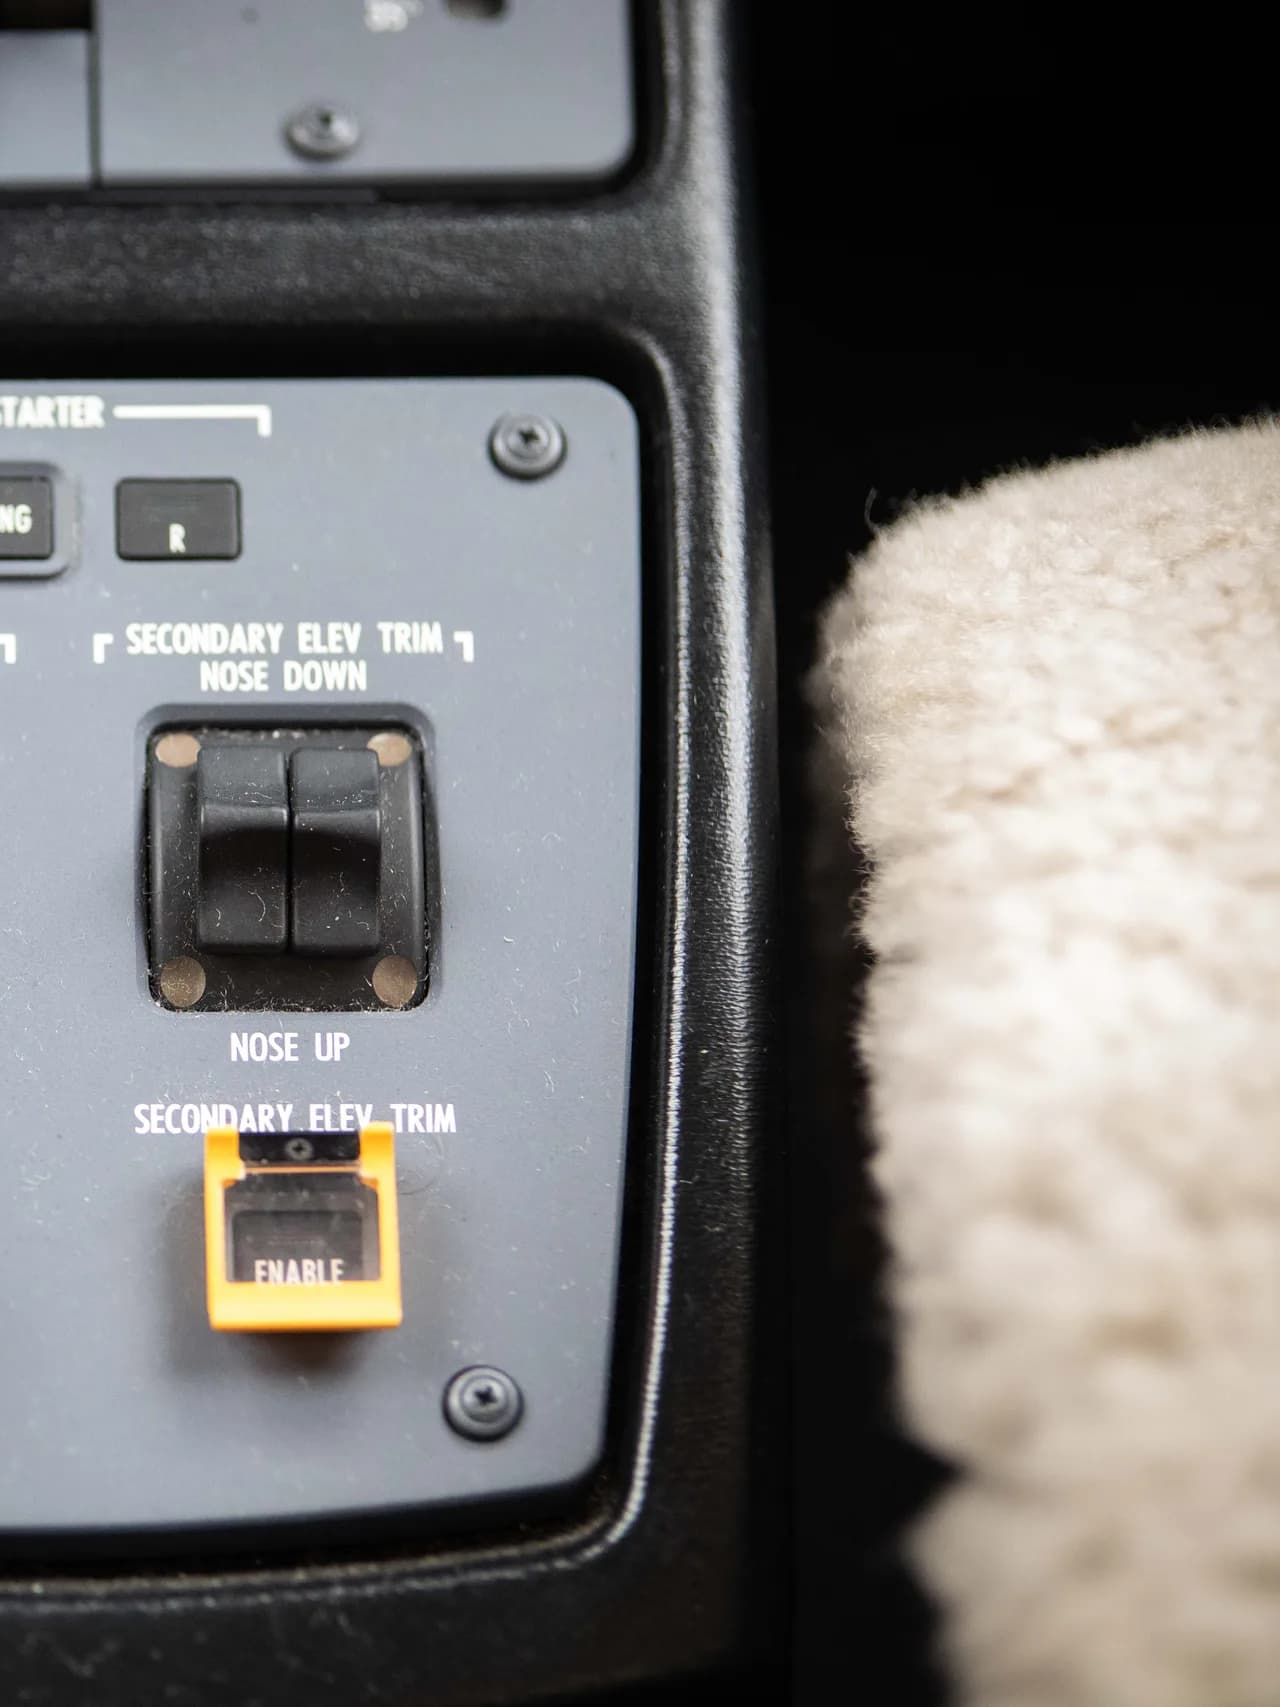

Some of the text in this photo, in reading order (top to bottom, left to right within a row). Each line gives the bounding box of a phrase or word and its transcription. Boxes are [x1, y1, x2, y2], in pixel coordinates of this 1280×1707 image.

[168, 523, 187, 554] R
[126, 621, 444, 655] SECONDARY ELEV TRIM
[199, 660, 368, 693] NOSE DOWN
[230, 1031, 351, 1062] NOSE UP
[133, 1103, 458, 1134] SECONDARY ELEV TRIM
[253, 1257, 345, 1286] ENABLE
